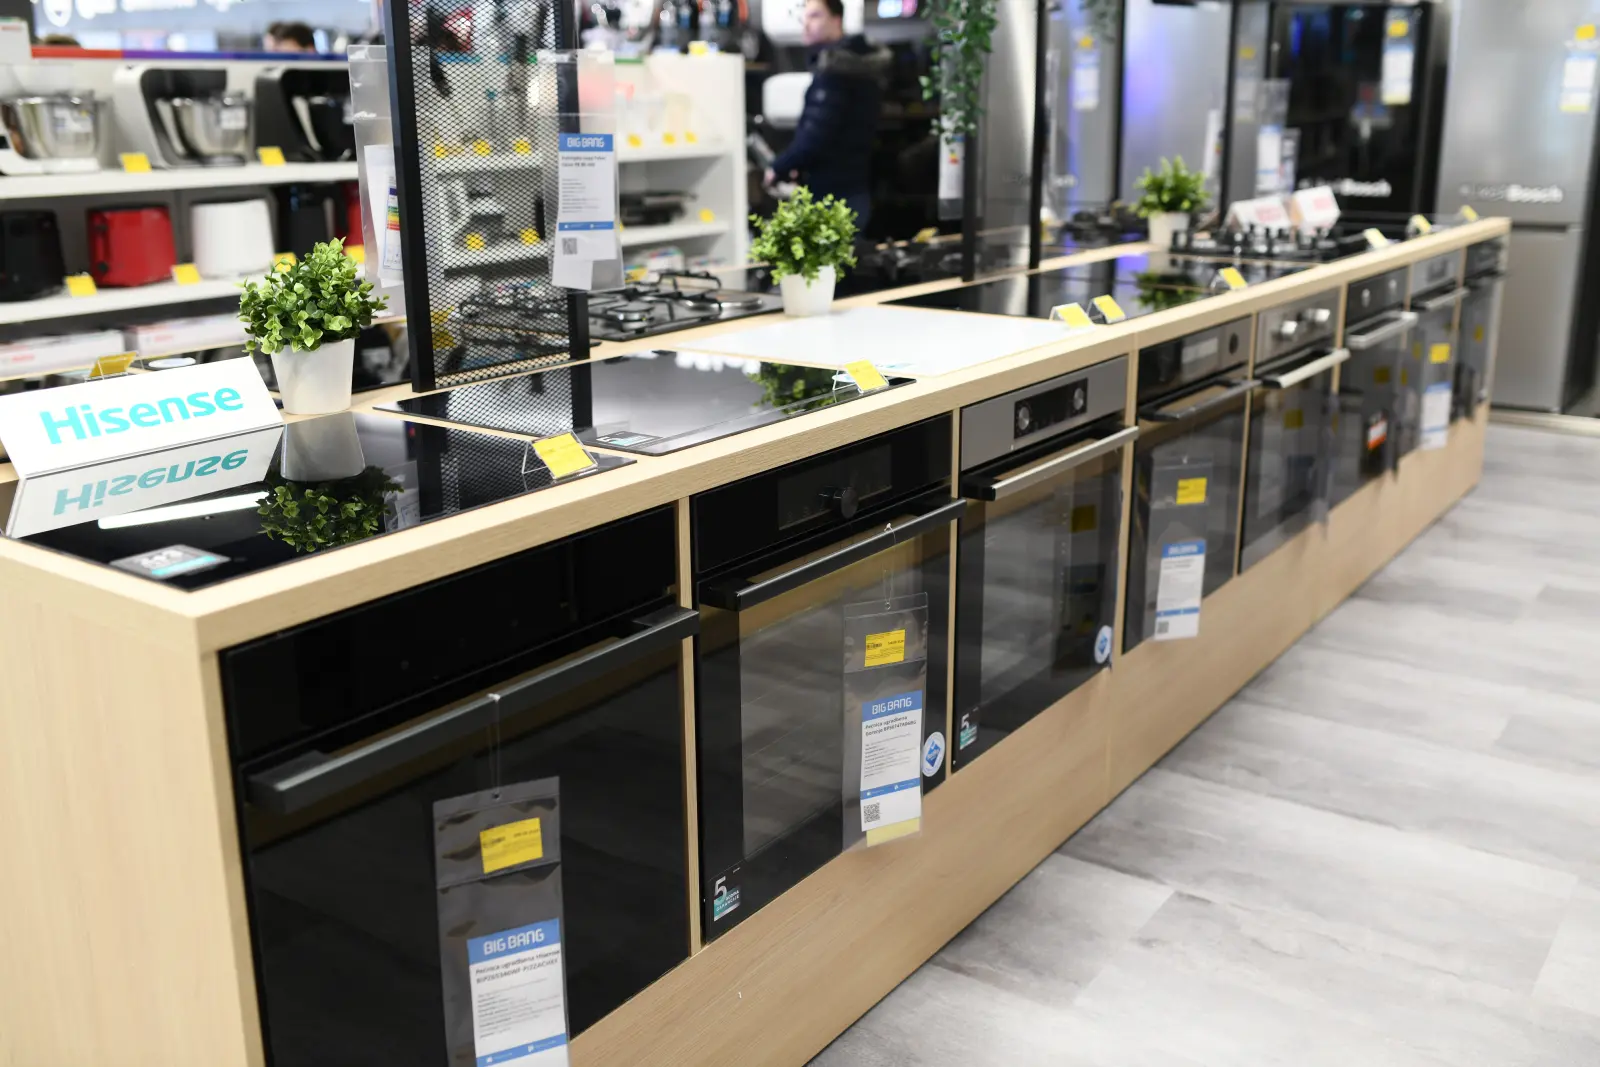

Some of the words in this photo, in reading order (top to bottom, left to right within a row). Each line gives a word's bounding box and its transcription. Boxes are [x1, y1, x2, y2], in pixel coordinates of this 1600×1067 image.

[567, 137, 580, 148] BIG
[581, 137, 605, 148] BANG
[39, 387, 244, 445] Hisense
[872, 703, 886, 715] BIG
[887, 697, 912, 711] BANG
[714, 876, 727, 905] 5
[483, 938, 507, 956] BIG
[507, 928, 546, 950] BANG
